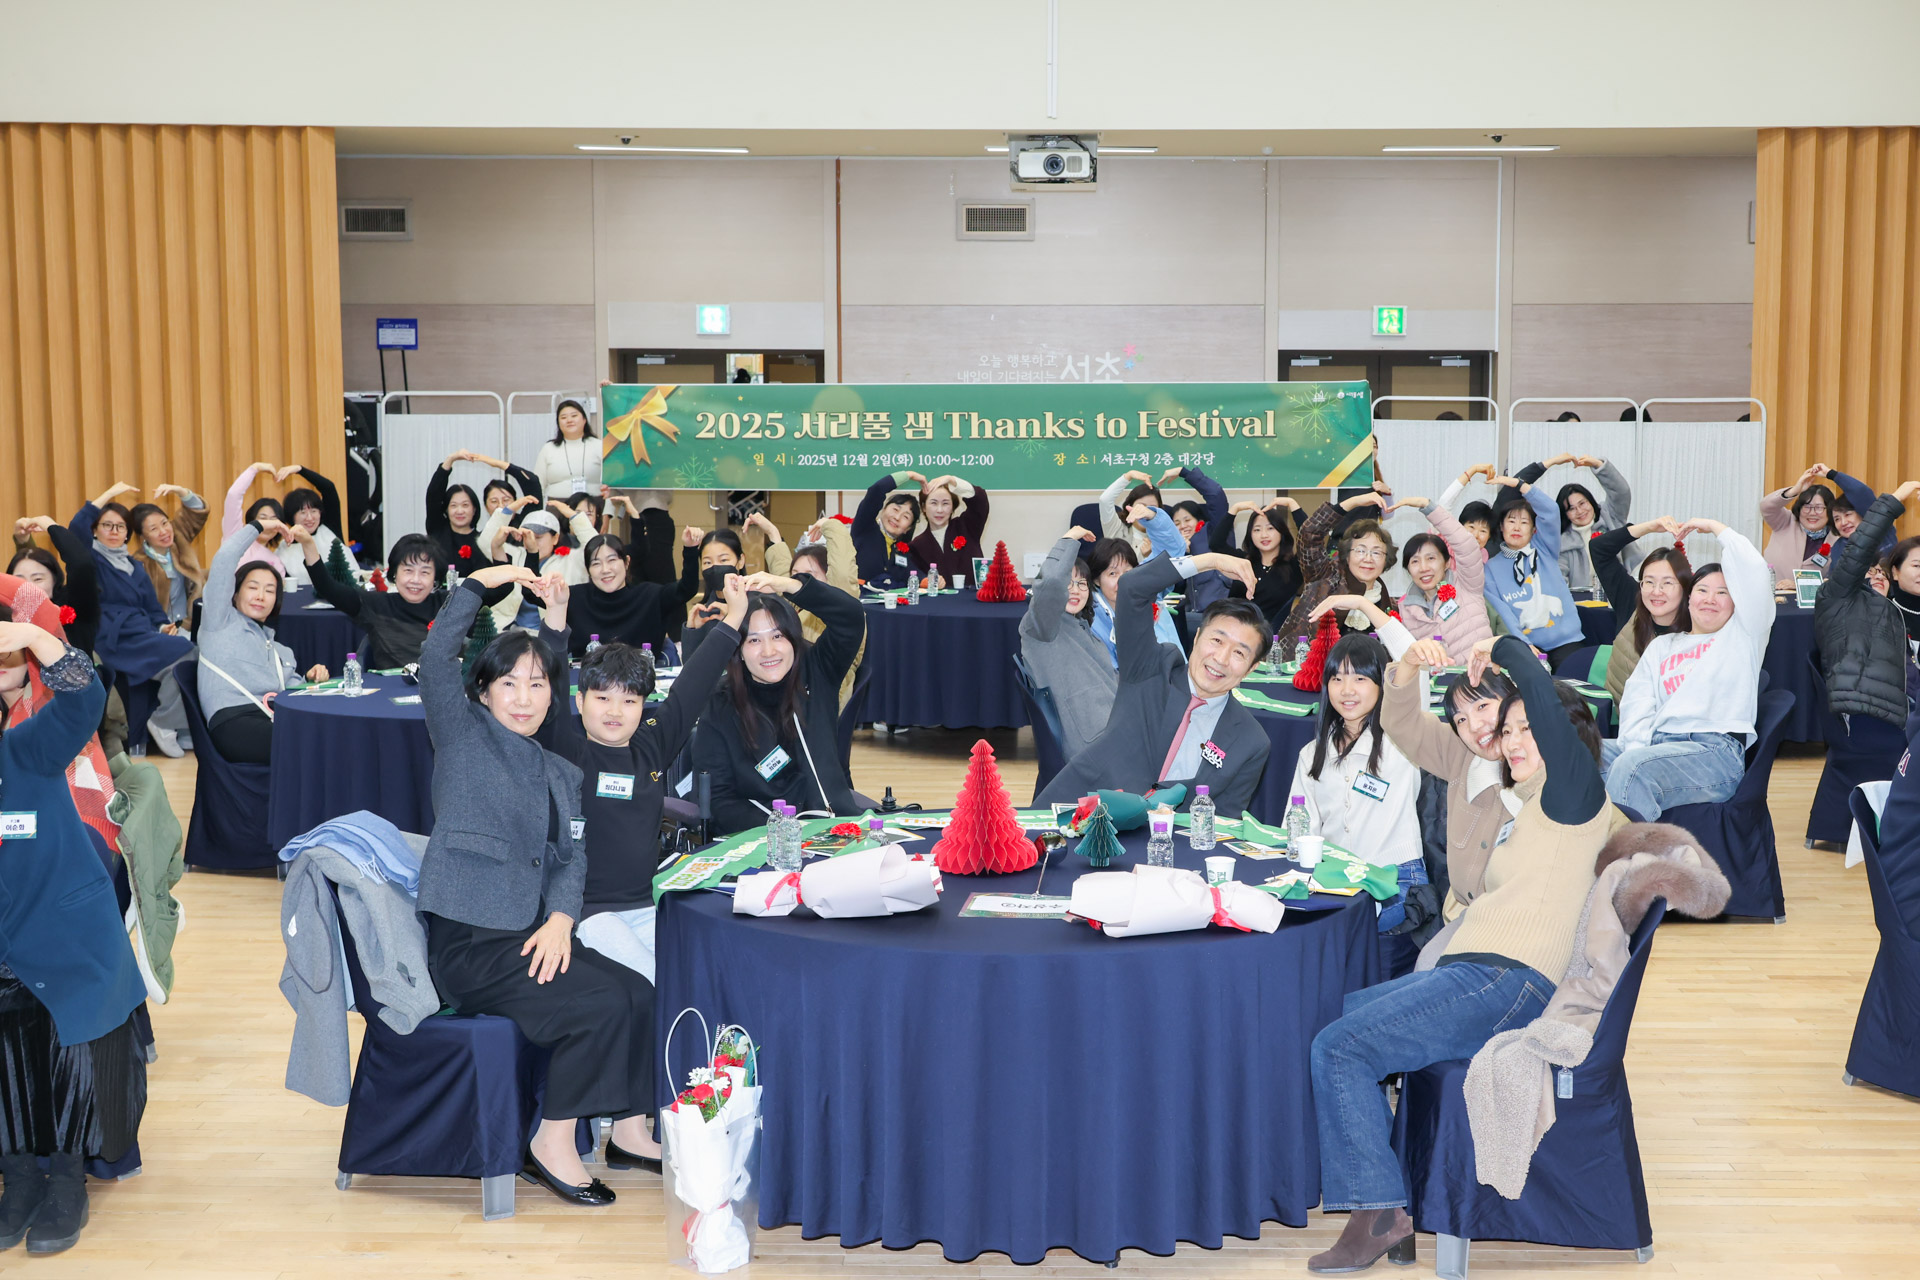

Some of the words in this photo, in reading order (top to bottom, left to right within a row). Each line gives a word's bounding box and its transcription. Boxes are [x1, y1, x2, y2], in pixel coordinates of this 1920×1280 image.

[978, 354, 1003, 368] 오늘
[1060, 351, 1123, 383] 서초
[957, 370, 992, 383] 내일이
[695, 411, 786, 440] 2025
[793, 411, 893, 441] 서리풀
[902, 411, 935, 441] 샘
[943, 410, 1085, 440] Thanks
[1094, 411, 1128, 440] to
[1137, 408, 1277, 439] Festival
[797, 454, 838, 467] 2025년
[842, 454, 869, 467] 12월
[872, 453, 914, 468] 2일(화)
[918, 455, 994, 467] 10:00~12:00
[1100, 453, 1151, 467] 서초구청
[1154, 453, 1175, 467] 2층
[1178, 453, 1216, 467] 대강당
